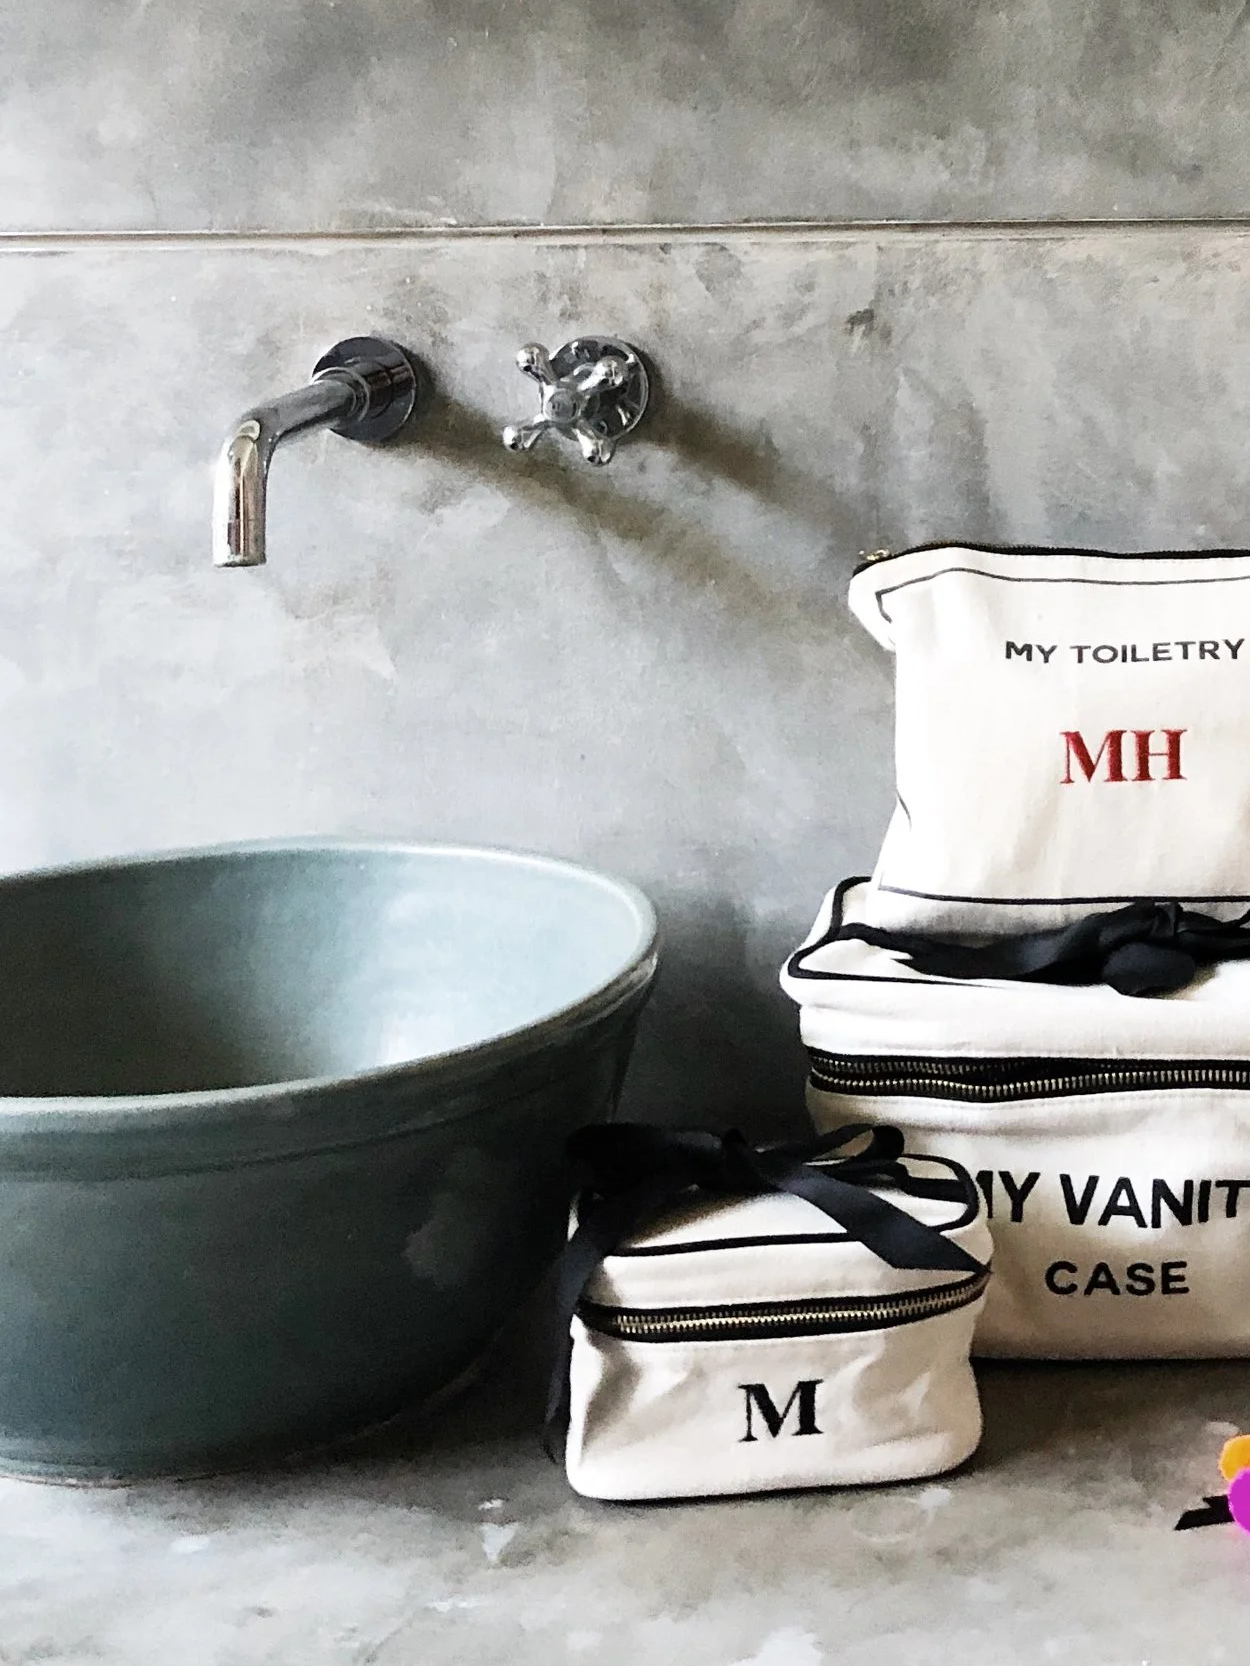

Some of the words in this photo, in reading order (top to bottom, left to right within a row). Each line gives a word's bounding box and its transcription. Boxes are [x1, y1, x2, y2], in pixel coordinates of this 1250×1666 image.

[1004, 639, 1056, 664] MY
[1069, 638, 1245, 664] TOILETRY
[1059, 728, 1188, 784] MH
[1045, 1261, 1189, 1296] CASE
[737, 1379, 824, 1442] M
